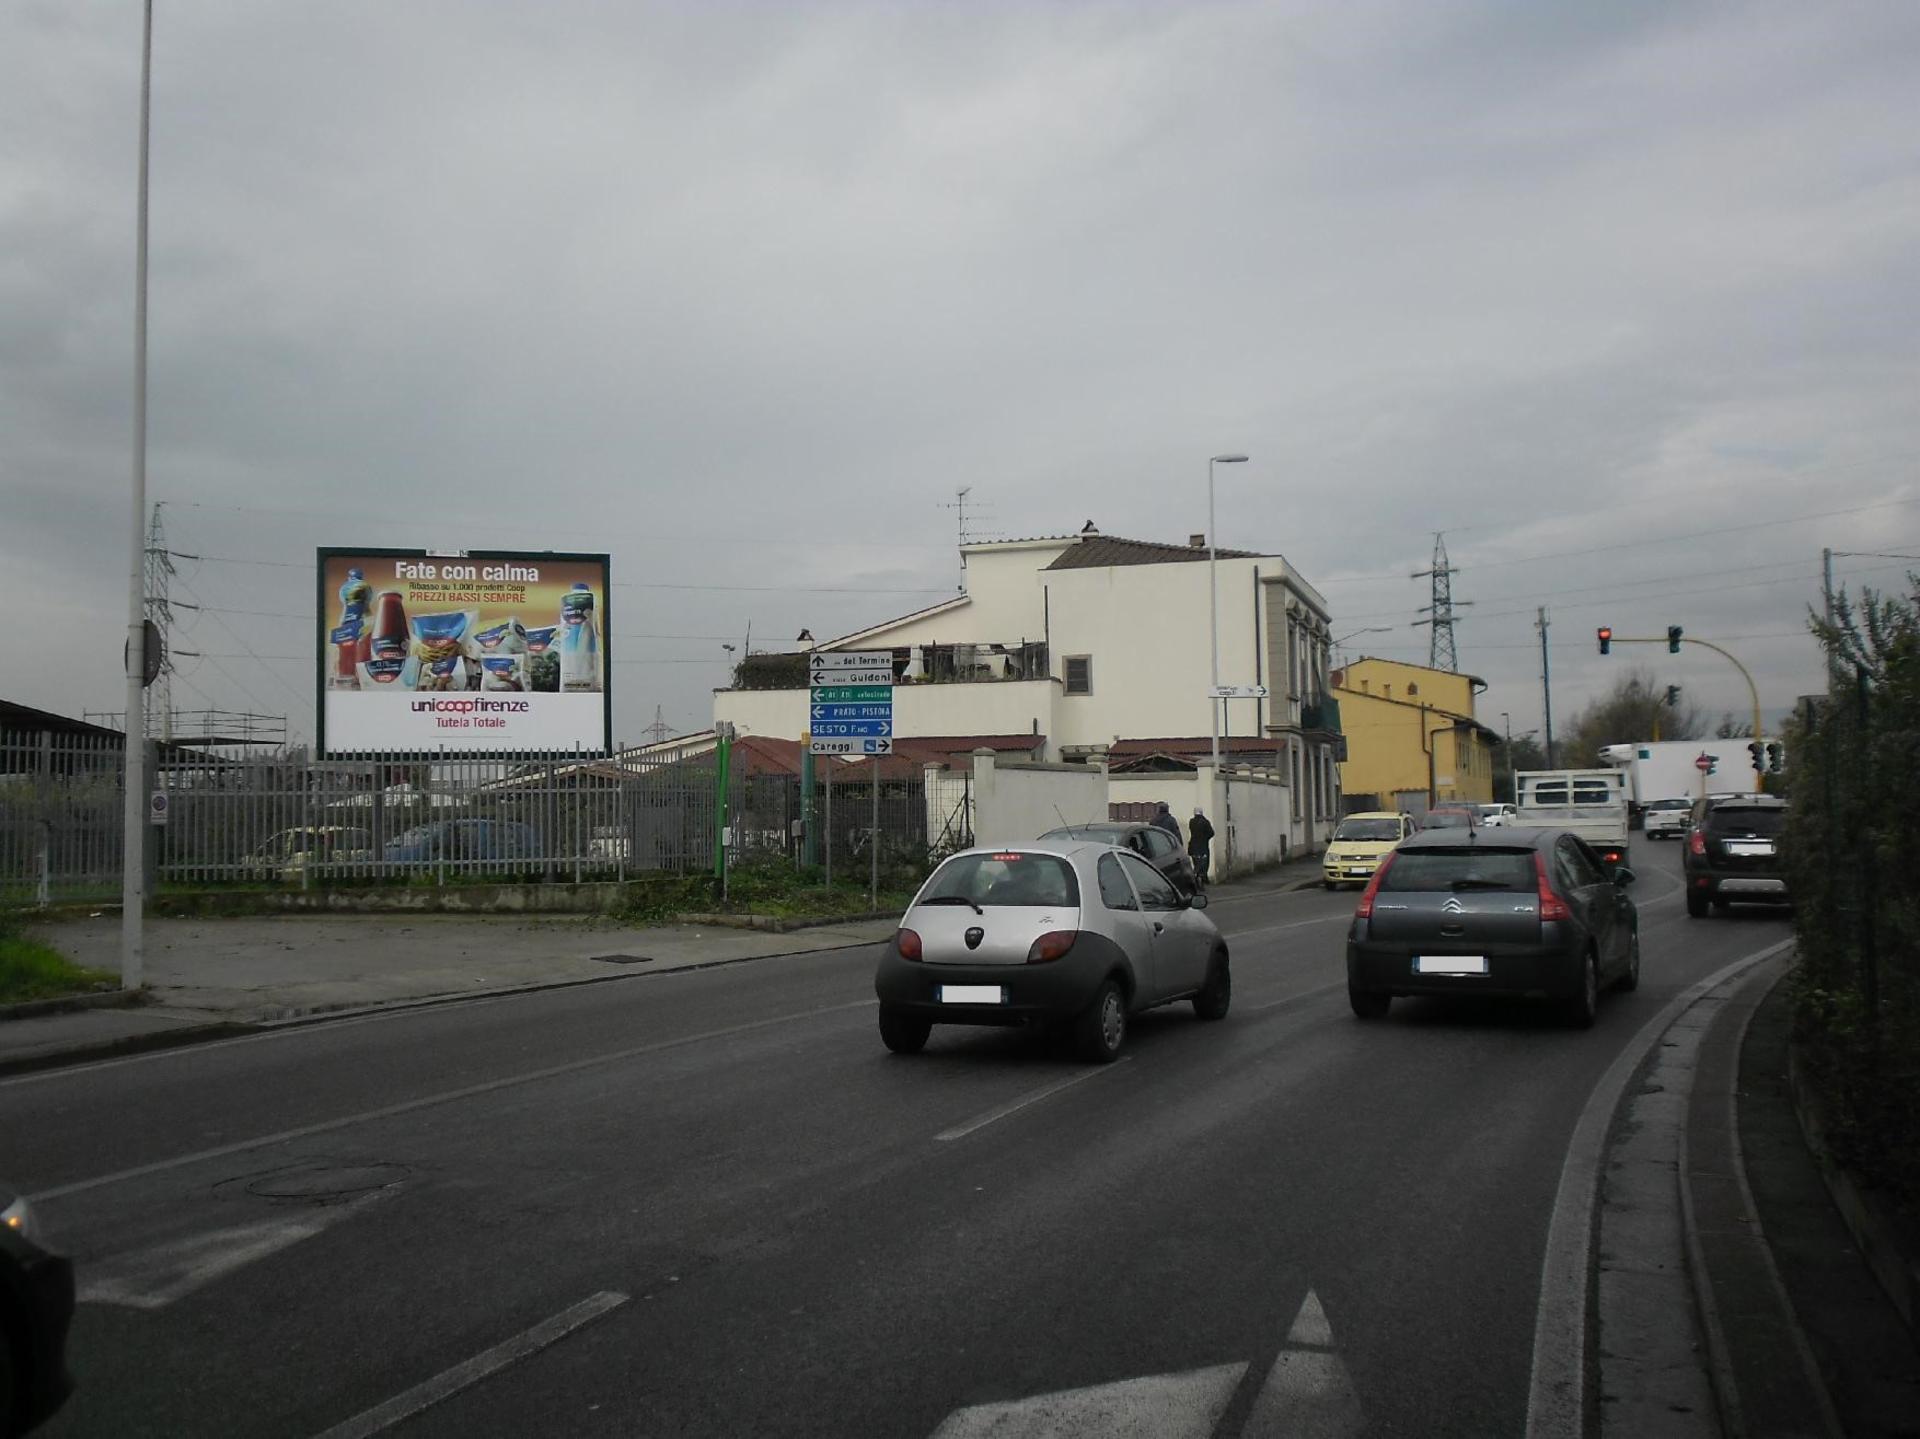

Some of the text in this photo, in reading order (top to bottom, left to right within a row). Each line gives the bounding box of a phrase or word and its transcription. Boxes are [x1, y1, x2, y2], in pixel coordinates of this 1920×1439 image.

[395, 561, 539, 581] Fate con calma
[408, 582, 439, 591] Ribasso
[506, 584, 526, 593] Coop
[409, 591, 527, 604] PREZZI BASSI SEMPRE
[843, 657, 856, 665] del
[858, 656, 890, 665] Termine
[850, 674, 891, 683] Guidoni
[411, 697, 529, 715] unicoopfirenze
[833, 707, 857, 716] PRATO
[435, 717, 506, 728] Tutela Totale
[812, 725, 847, 734] SESTO
[812, 741, 854, 752] Careggi
